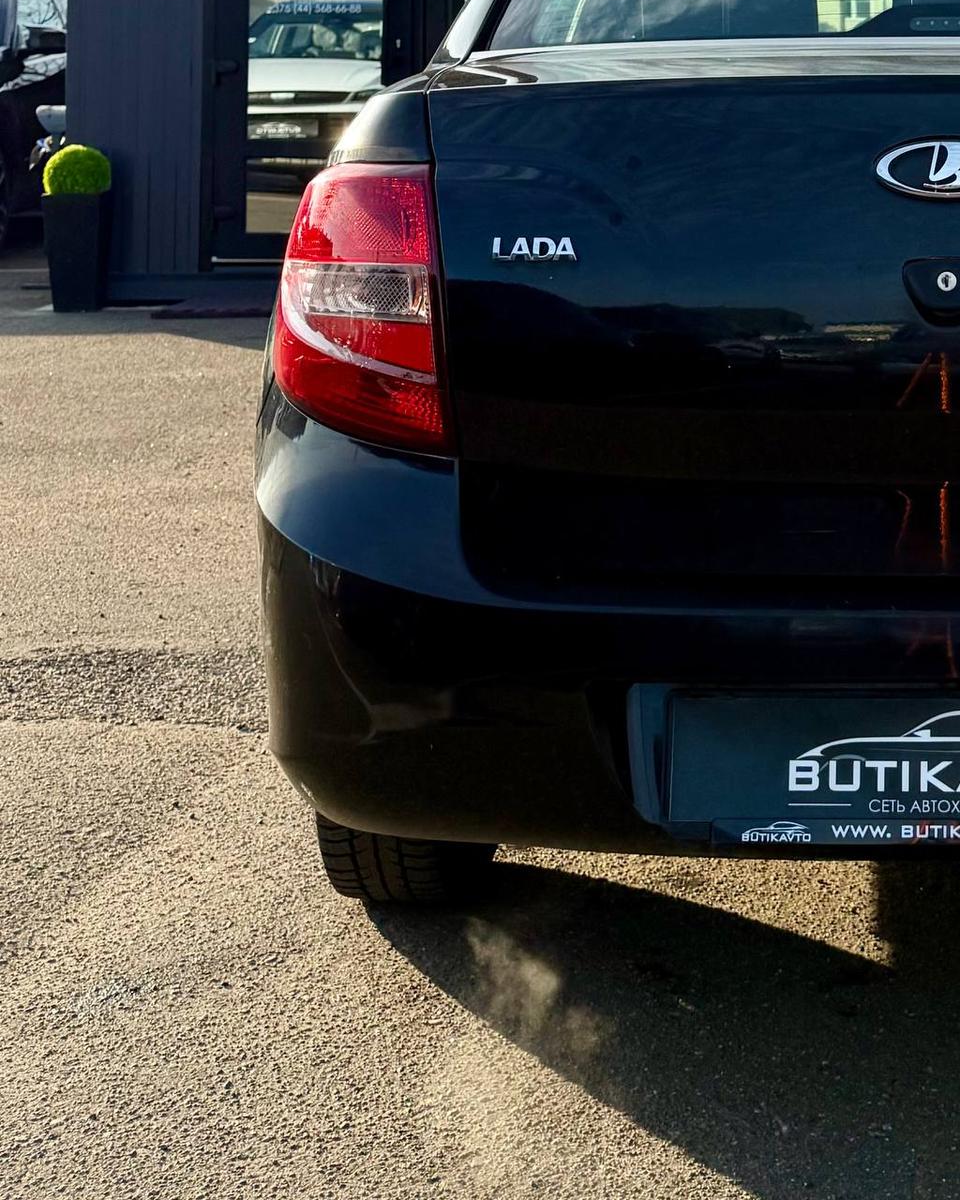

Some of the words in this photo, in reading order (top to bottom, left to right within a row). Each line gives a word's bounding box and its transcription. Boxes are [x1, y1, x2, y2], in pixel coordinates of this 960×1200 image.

[492, 236, 577, 261] LADA
[868, 799, 906, 814] СЕТЬ
[741, 833, 812, 842] BUTIKAVTO
[831, 824, 892, 839] WWW.
